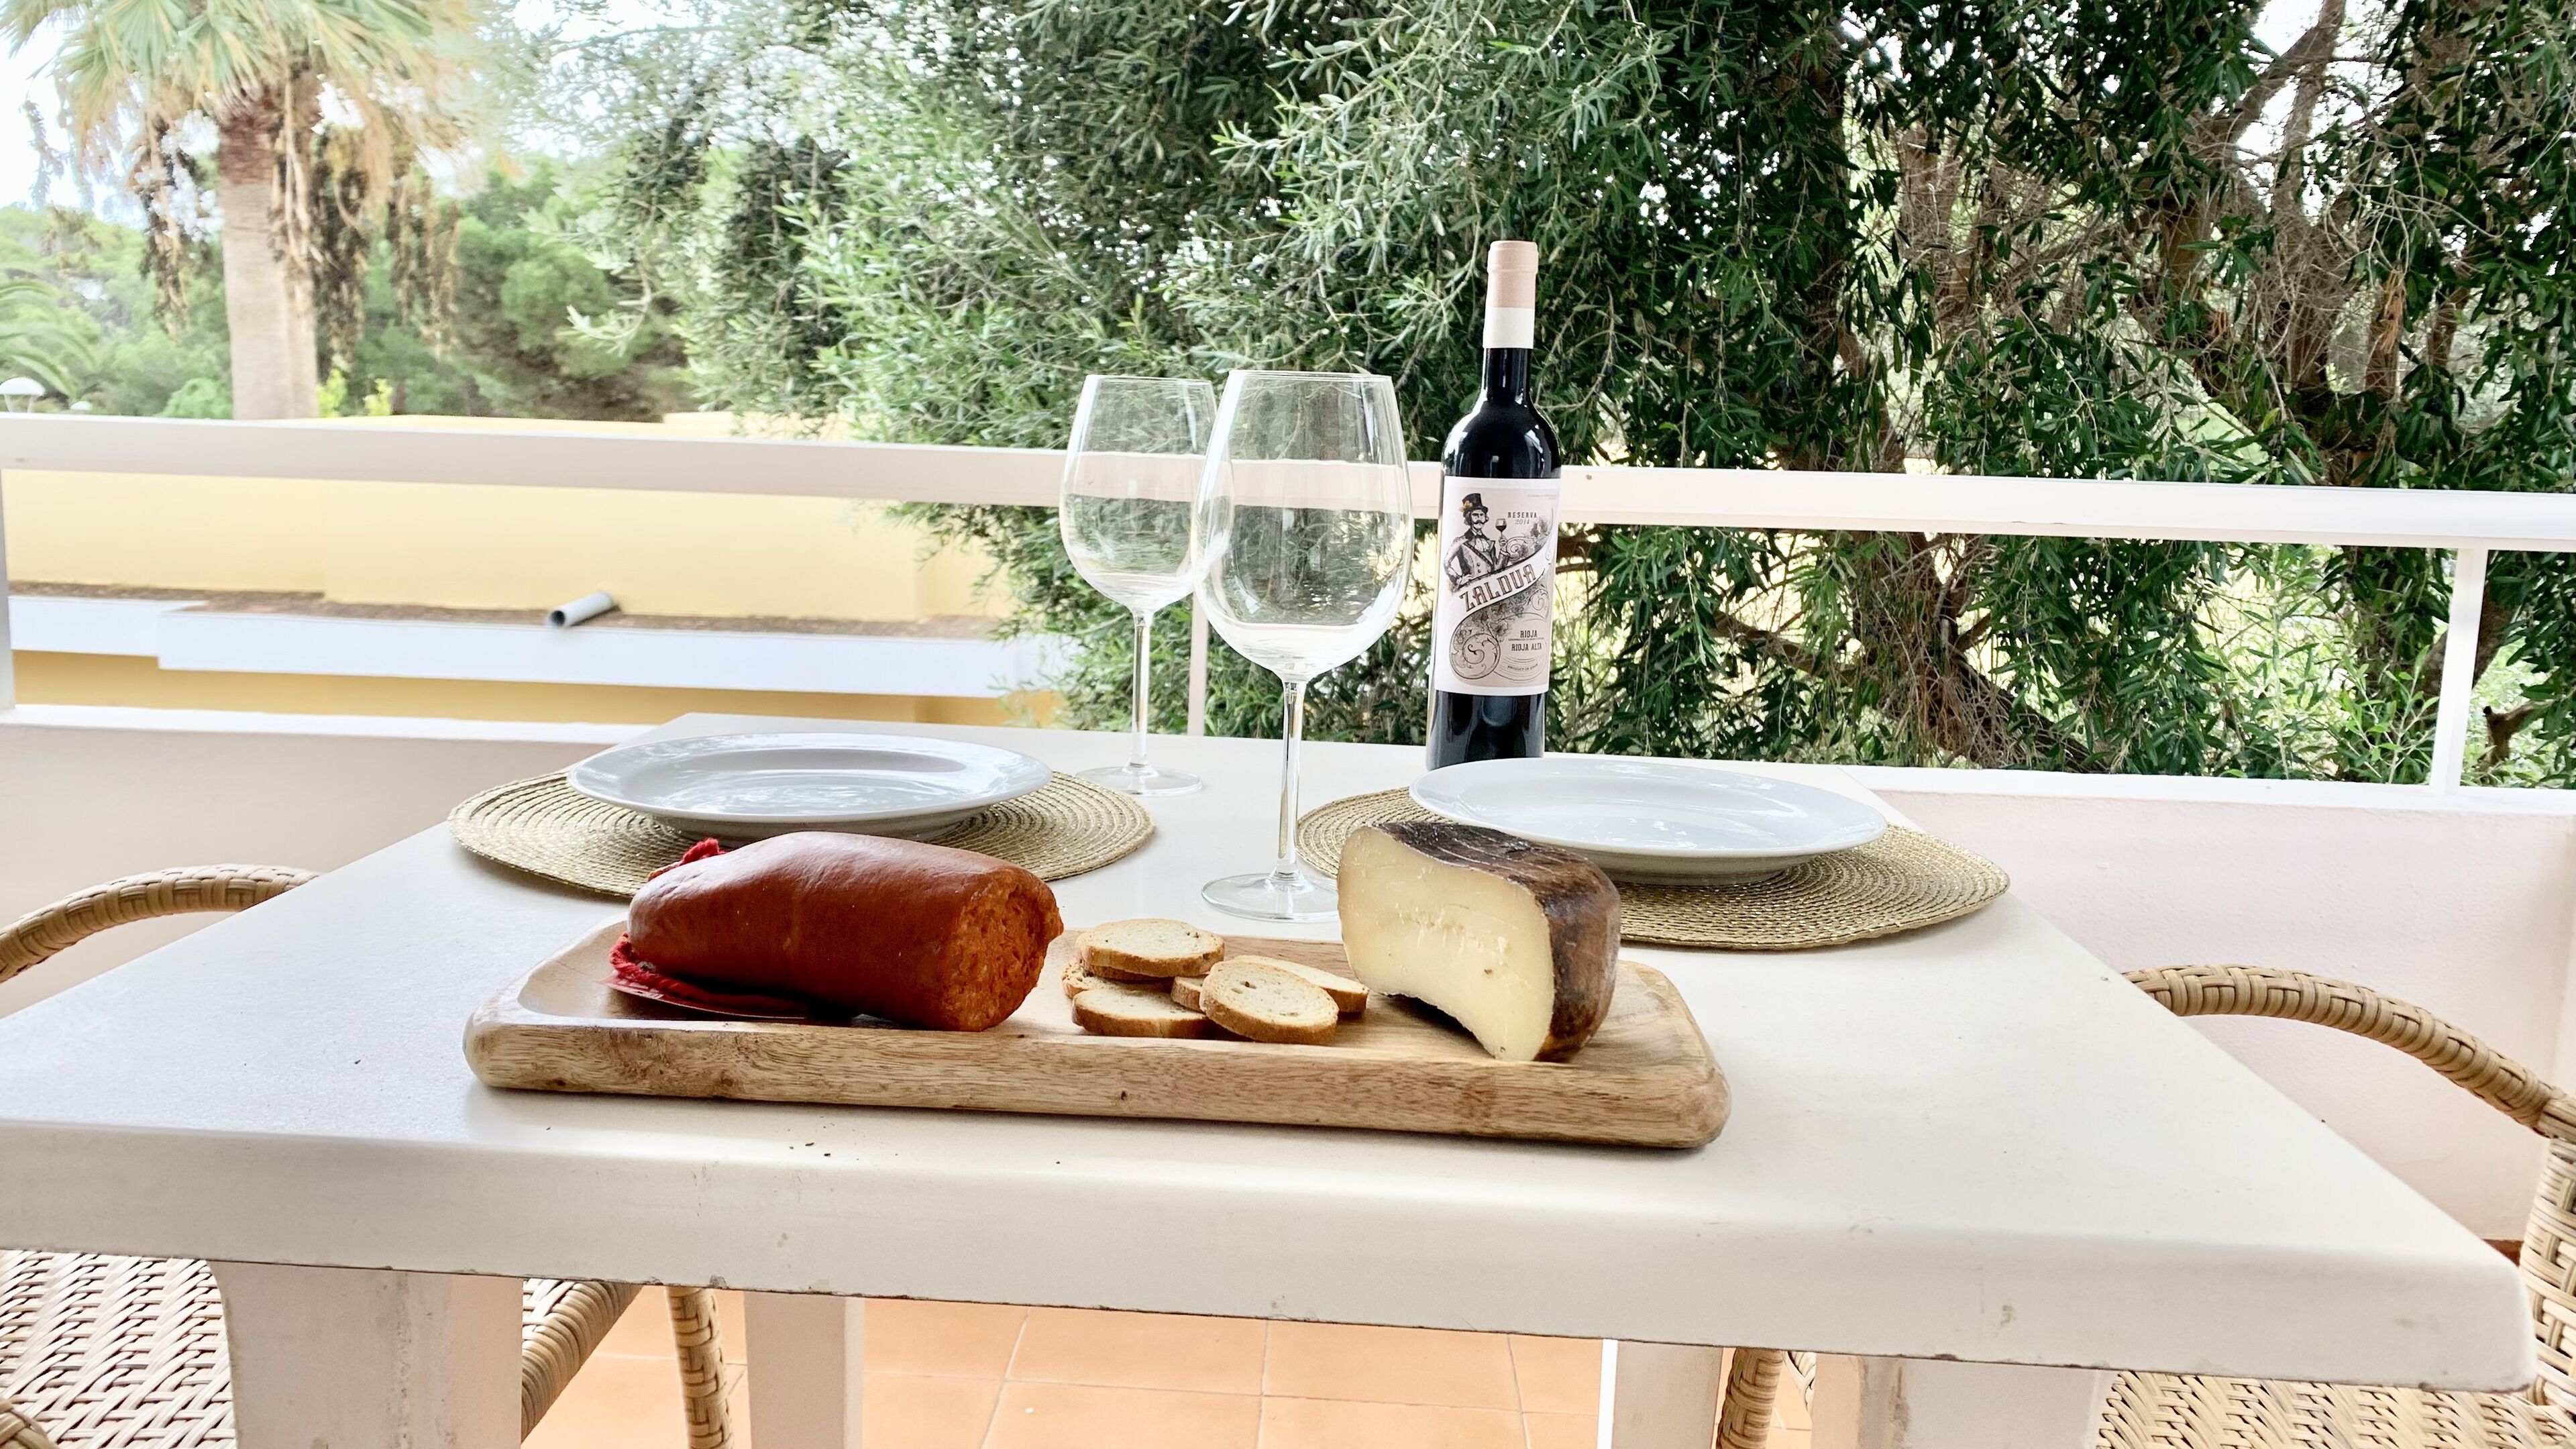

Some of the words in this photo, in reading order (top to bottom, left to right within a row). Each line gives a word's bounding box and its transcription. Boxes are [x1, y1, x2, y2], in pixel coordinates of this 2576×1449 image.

[1459, 564, 1536, 612] ZALDUA
[1520, 630, 1538, 638] RIOJA
[1511, 643, 1529, 651] RIOJA
